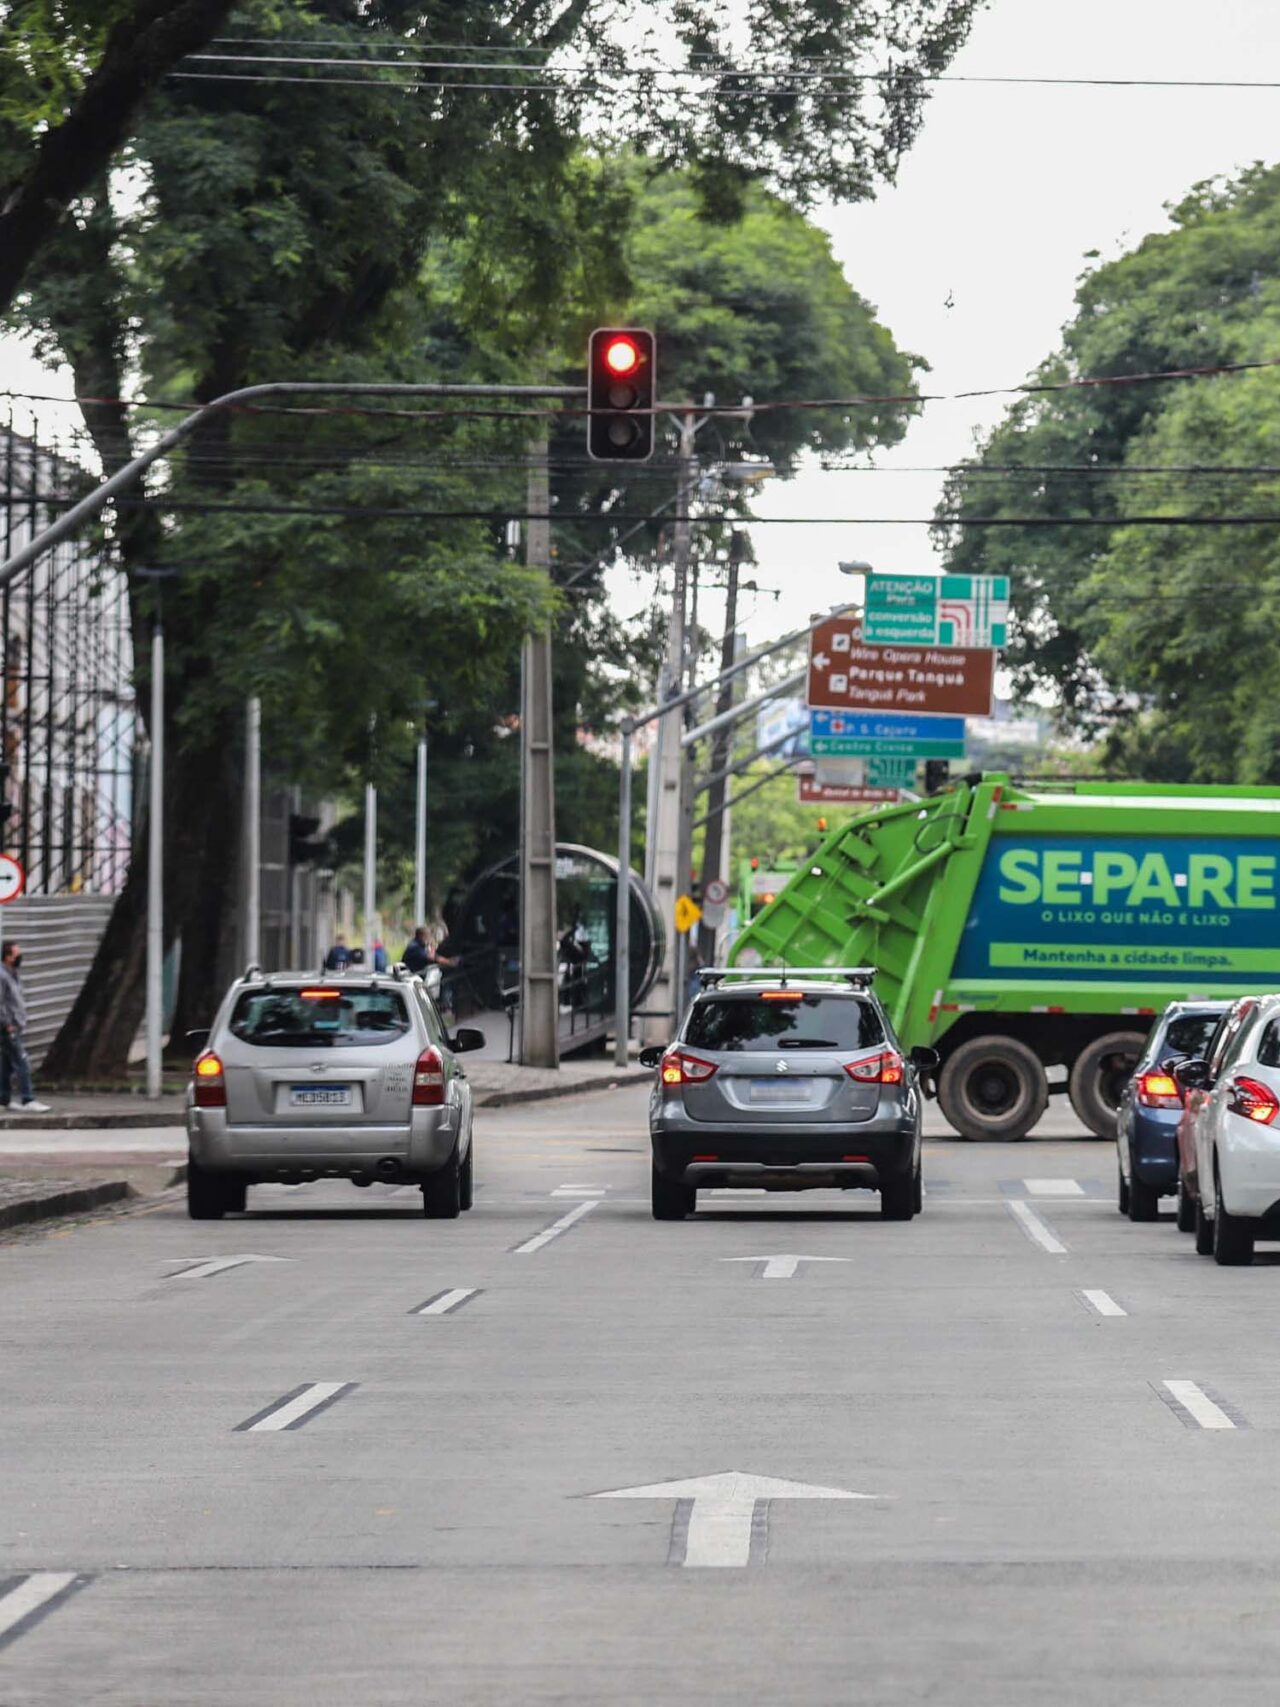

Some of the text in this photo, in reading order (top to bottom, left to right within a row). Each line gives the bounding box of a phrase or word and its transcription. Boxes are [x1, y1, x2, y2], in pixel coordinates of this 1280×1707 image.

[869, 579, 933, 595] ATENÇÃO
[868, 610, 933, 624] conversão
[882, 648, 922, 665] Opera
[925, 651, 966, 666] House
[849, 665, 964, 688] Parque Tanguá
[896, 688, 926, 702] Park
[1041, 910, 1230, 926] O LIXO QUE NÃO É LIXO
[1022, 948, 1234, 968] Mantenha a cidade limpa.
